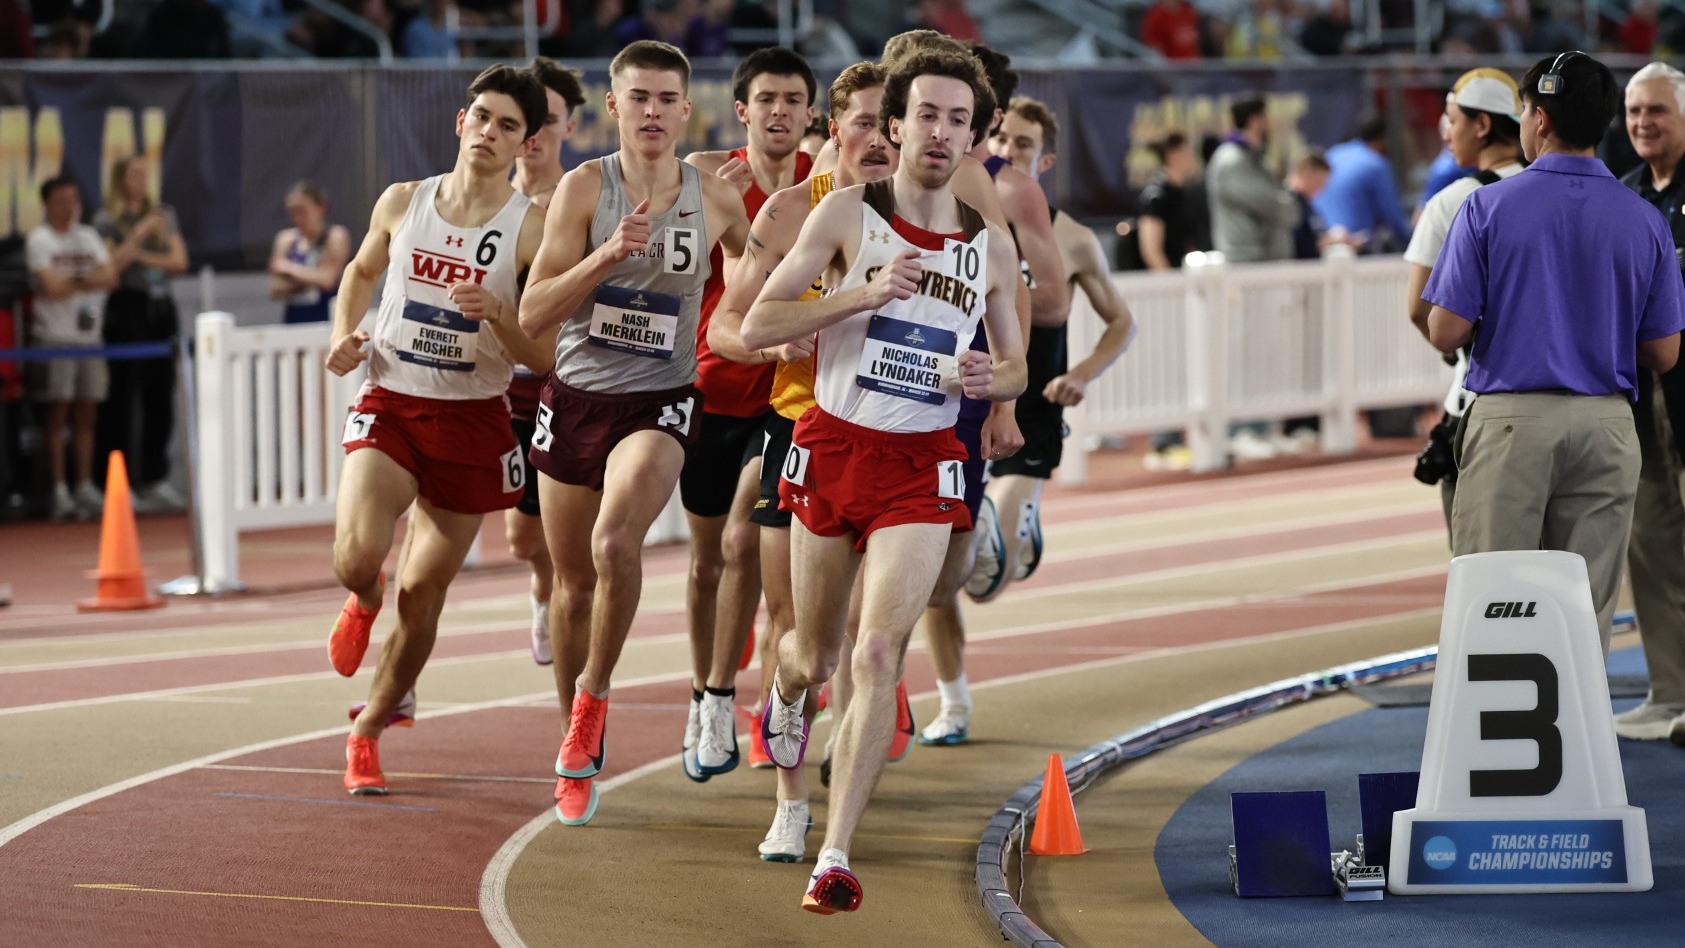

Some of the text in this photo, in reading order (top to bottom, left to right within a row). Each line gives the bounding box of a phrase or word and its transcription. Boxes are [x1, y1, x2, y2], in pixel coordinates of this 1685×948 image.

[475, 230, 503, 266] 6
[672, 231, 692, 272] 5
[952, 243, 980, 281] 10
[913, 268, 978, 318] WRENCE
[621, 313, 651, 328] NASH
[419, 327, 459, 345] EVERETT
[601, 322, 666, 346] MERKLEIN
[412, 338, 463, 359] MOSHER
[881, 346, 939, 370] NICHOLAS
[870, 359, 942, 390] LYNDAKER
[507, 452, 522, 488] 6
[1484, 602, 1538, 619] GILL
[1467, 653, 1563, 798] 3
[1491, 834, 1590, 850] TRACK & FIELD
[1426, 851, 1457, 863] NCAA
[1468, 851, 1613, 871] CHAMPIONSHIPS
[1348, 867, 1381, 875] GILL
